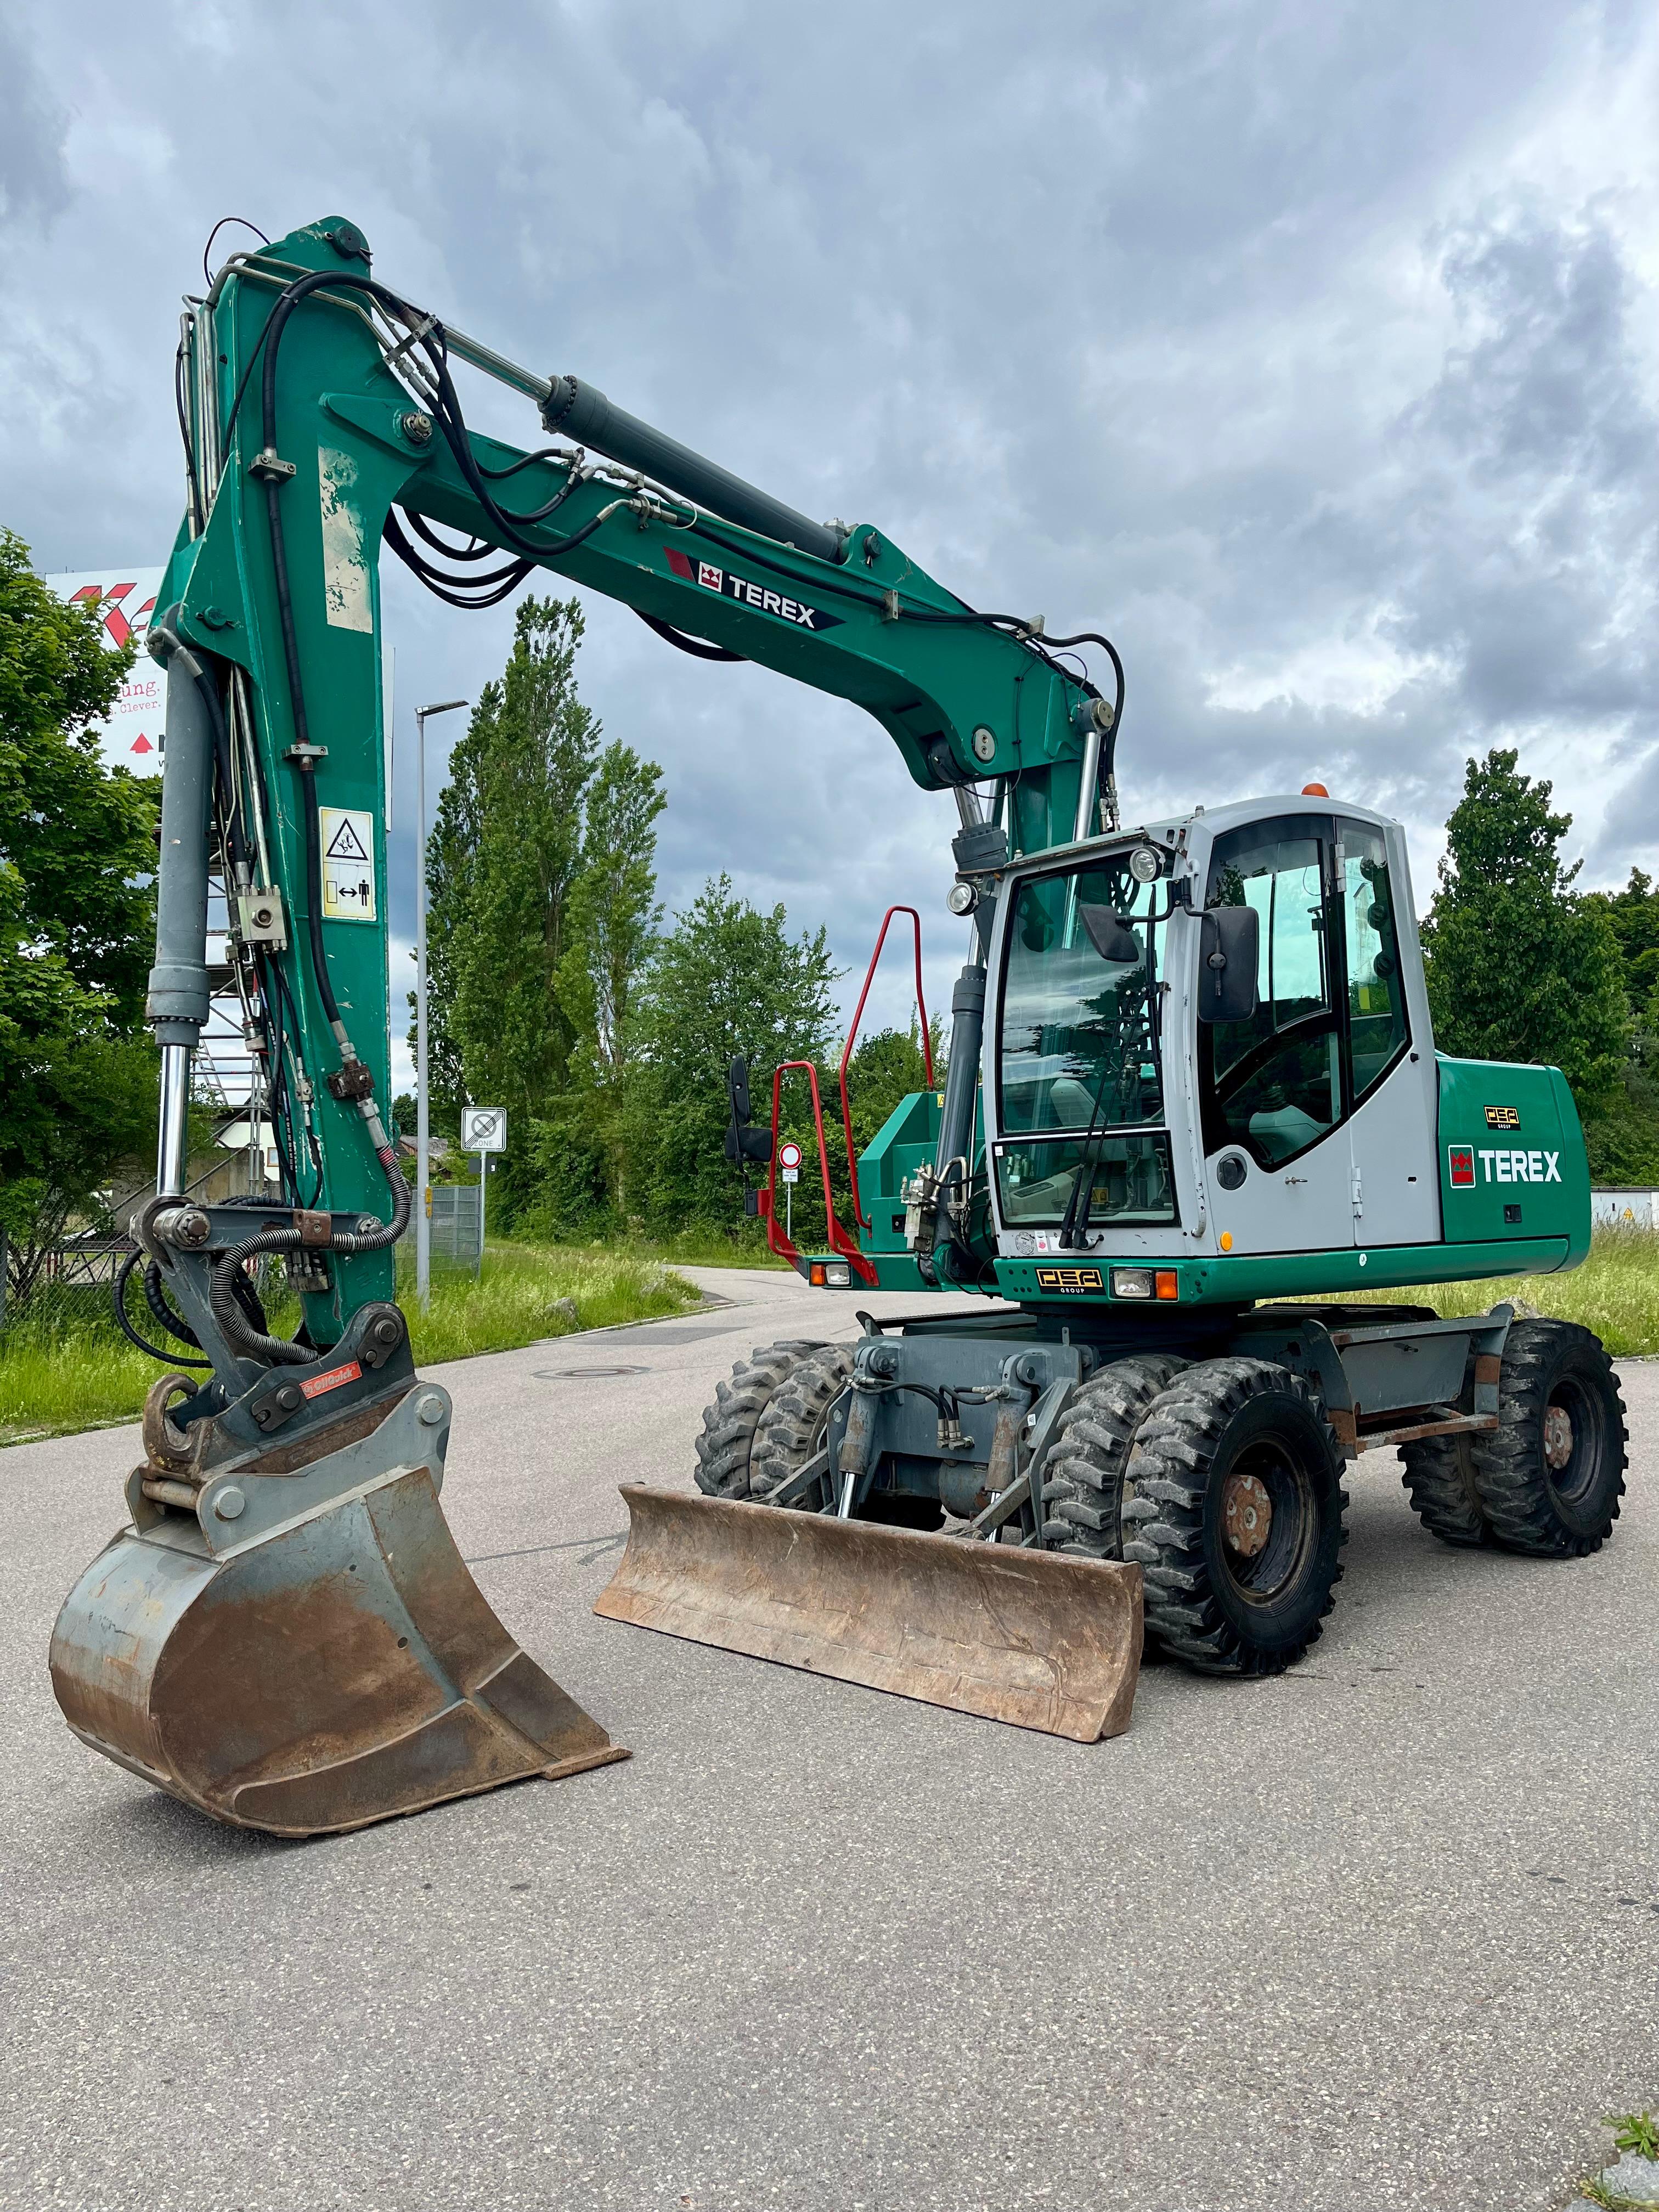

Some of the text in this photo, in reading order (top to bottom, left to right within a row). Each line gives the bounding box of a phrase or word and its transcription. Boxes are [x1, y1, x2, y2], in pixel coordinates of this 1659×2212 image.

[729, 575, 815, 629] TEREX
[121, 681, 160, 697] ung.
[120, 701, 161, 713] Clever.
[1478, 1150, 1562, 1182] TEREX
